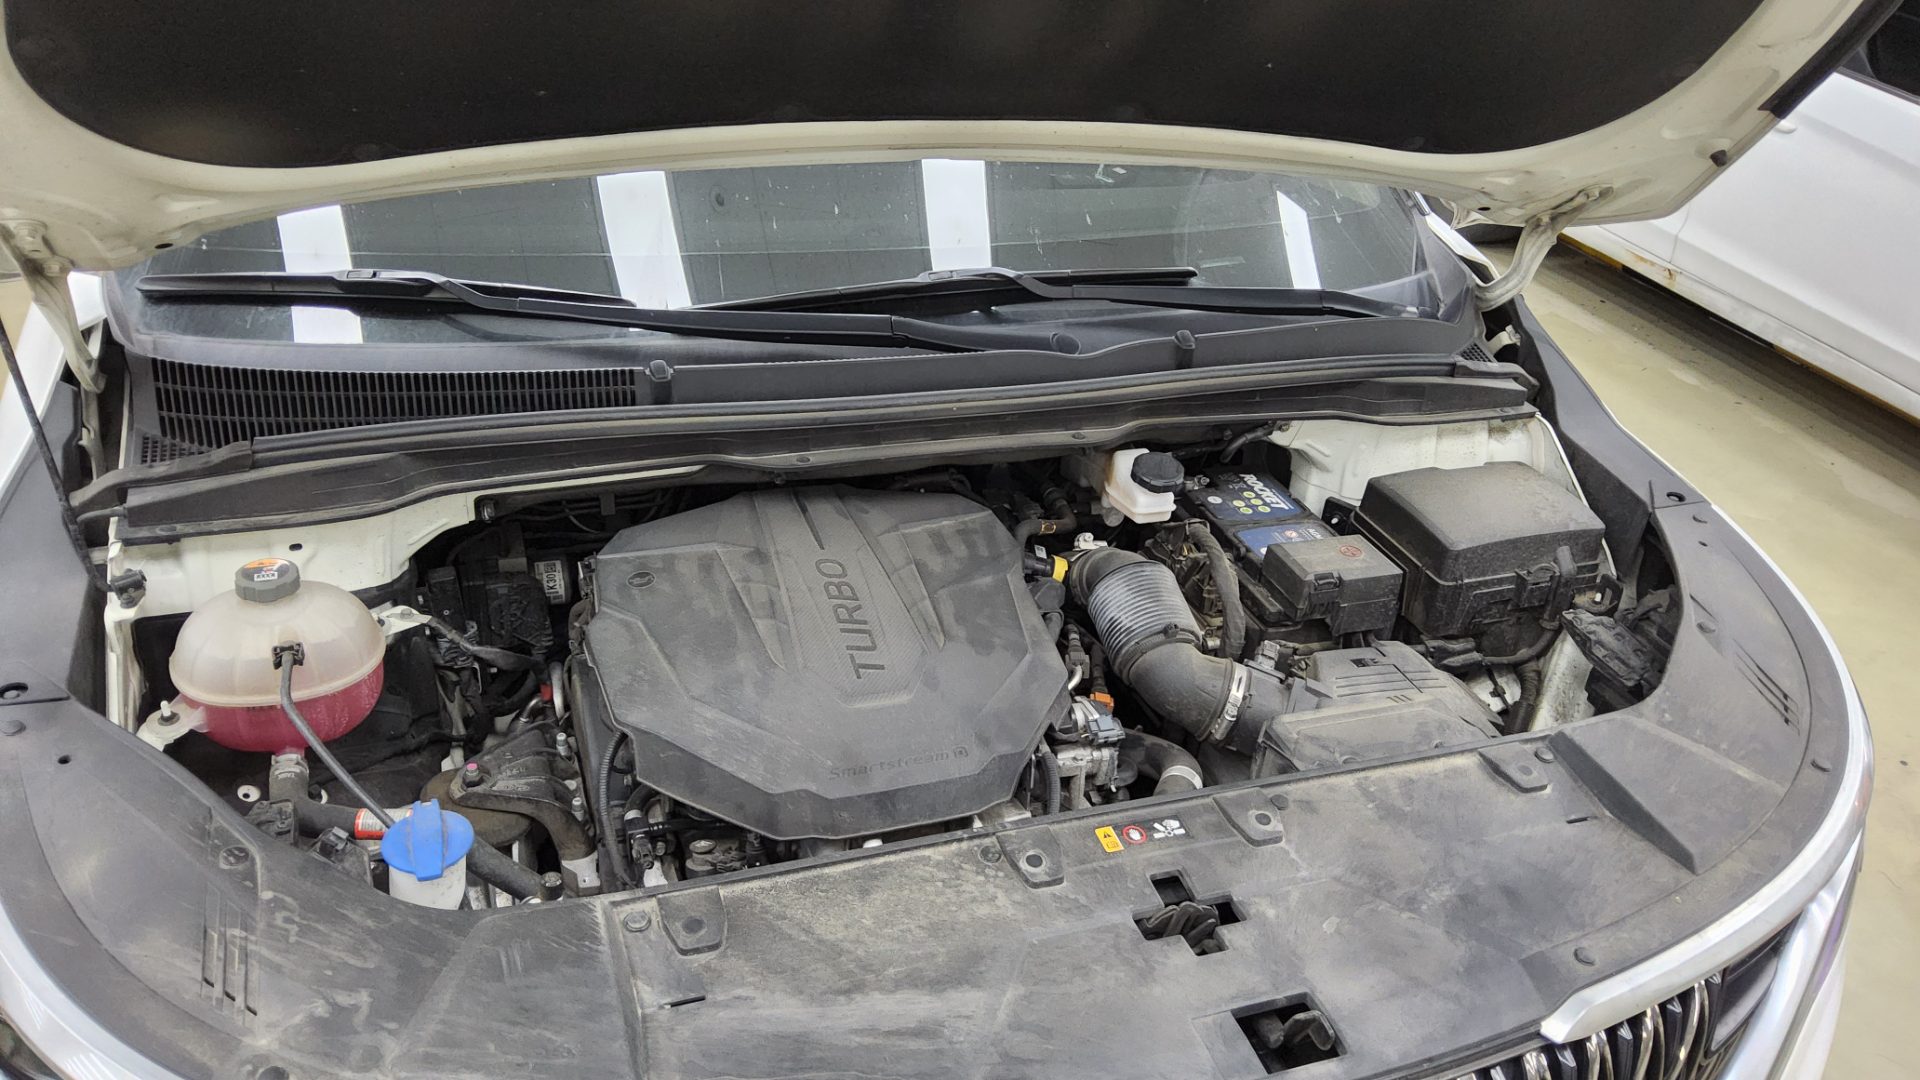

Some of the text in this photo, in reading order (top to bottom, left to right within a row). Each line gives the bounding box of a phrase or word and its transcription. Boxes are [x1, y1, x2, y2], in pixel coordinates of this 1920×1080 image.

[1238, 474, 1289, 510] ROCKET
[815, 558, 885, 679] TURBO
[828, 750, 950, 780] Smartstream
